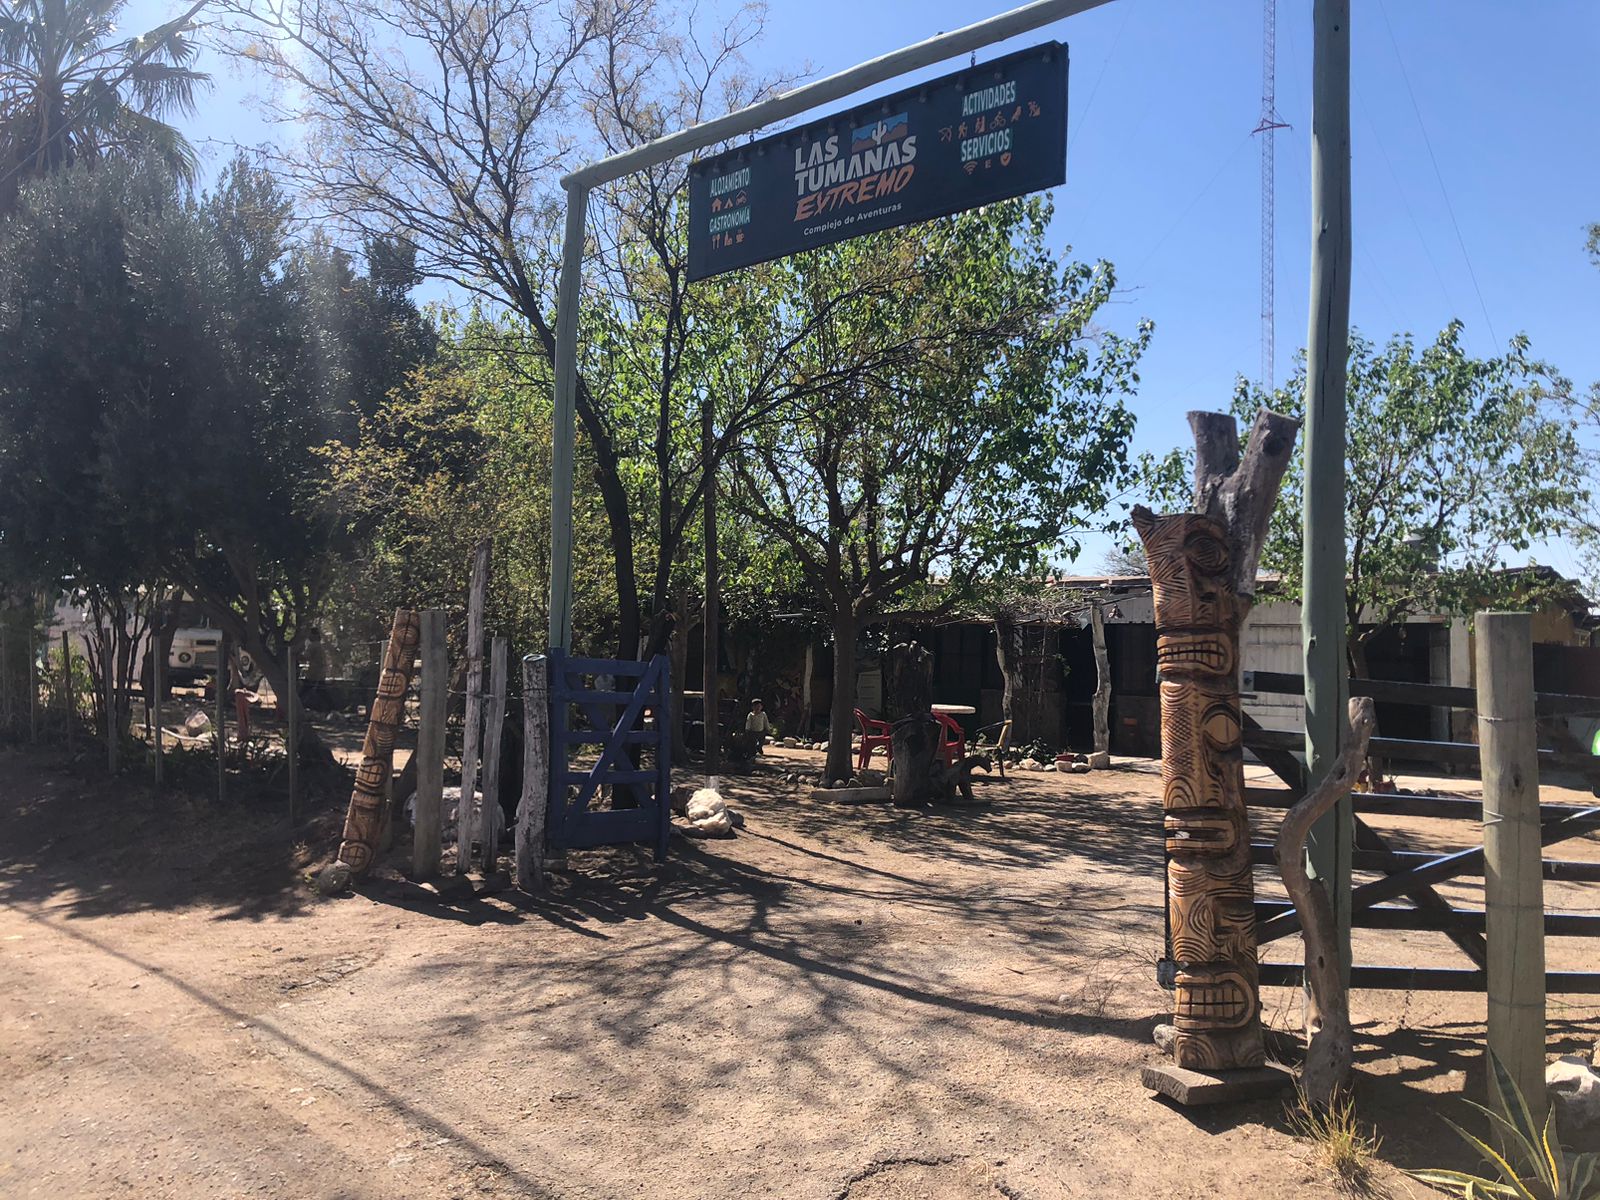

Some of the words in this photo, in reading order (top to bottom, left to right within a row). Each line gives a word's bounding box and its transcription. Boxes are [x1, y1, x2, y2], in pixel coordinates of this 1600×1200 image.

[962, 81, 1016, 117] ACTIVIDADES
[795, 135, 839, 172] LAS
[961, 128, 1010, 162] SERVICIOS
[710, 167, 751, 198] ALOJAMIENTO
[795, 135, 917, 196] TUMANAS
[794, 164, 915, 222] EXTREMO
[803, 219, 842, 236] Complejo
[844, 215, 855, 225] de
[857, 202, 902, 221] Aventuras
